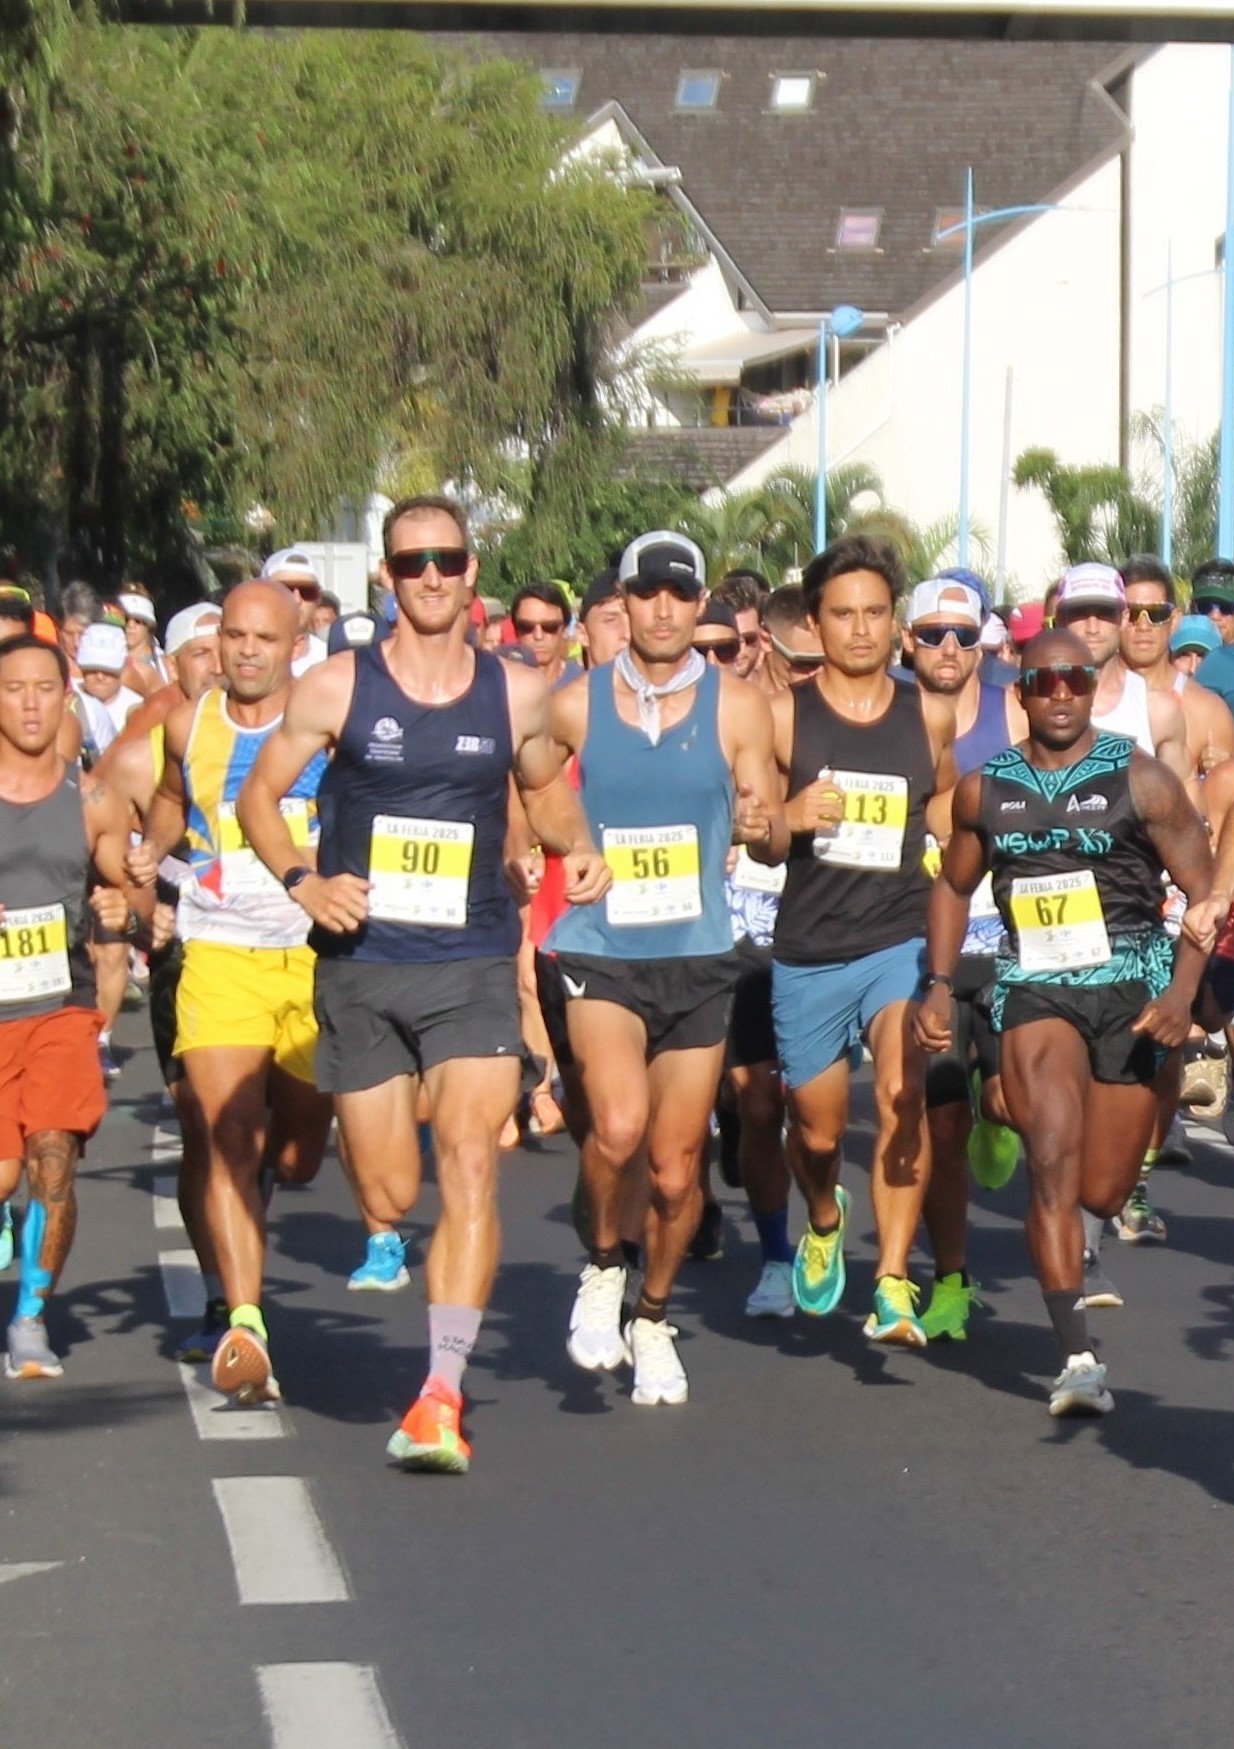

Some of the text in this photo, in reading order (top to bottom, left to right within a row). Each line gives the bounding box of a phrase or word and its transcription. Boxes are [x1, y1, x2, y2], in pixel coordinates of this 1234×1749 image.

[402, 824, 429, 836] FERIA
[432, 827, 459, 840] 2025
[401, 840, 440, 876] 90
[631, 847, 670, 879] 56
[1030, 881, 1054, 894] FERIA
[1056, 877, 1082, 891] 2025
[1035, 893, 1069, 926] 67
[0, 925, 50, 958] 181
